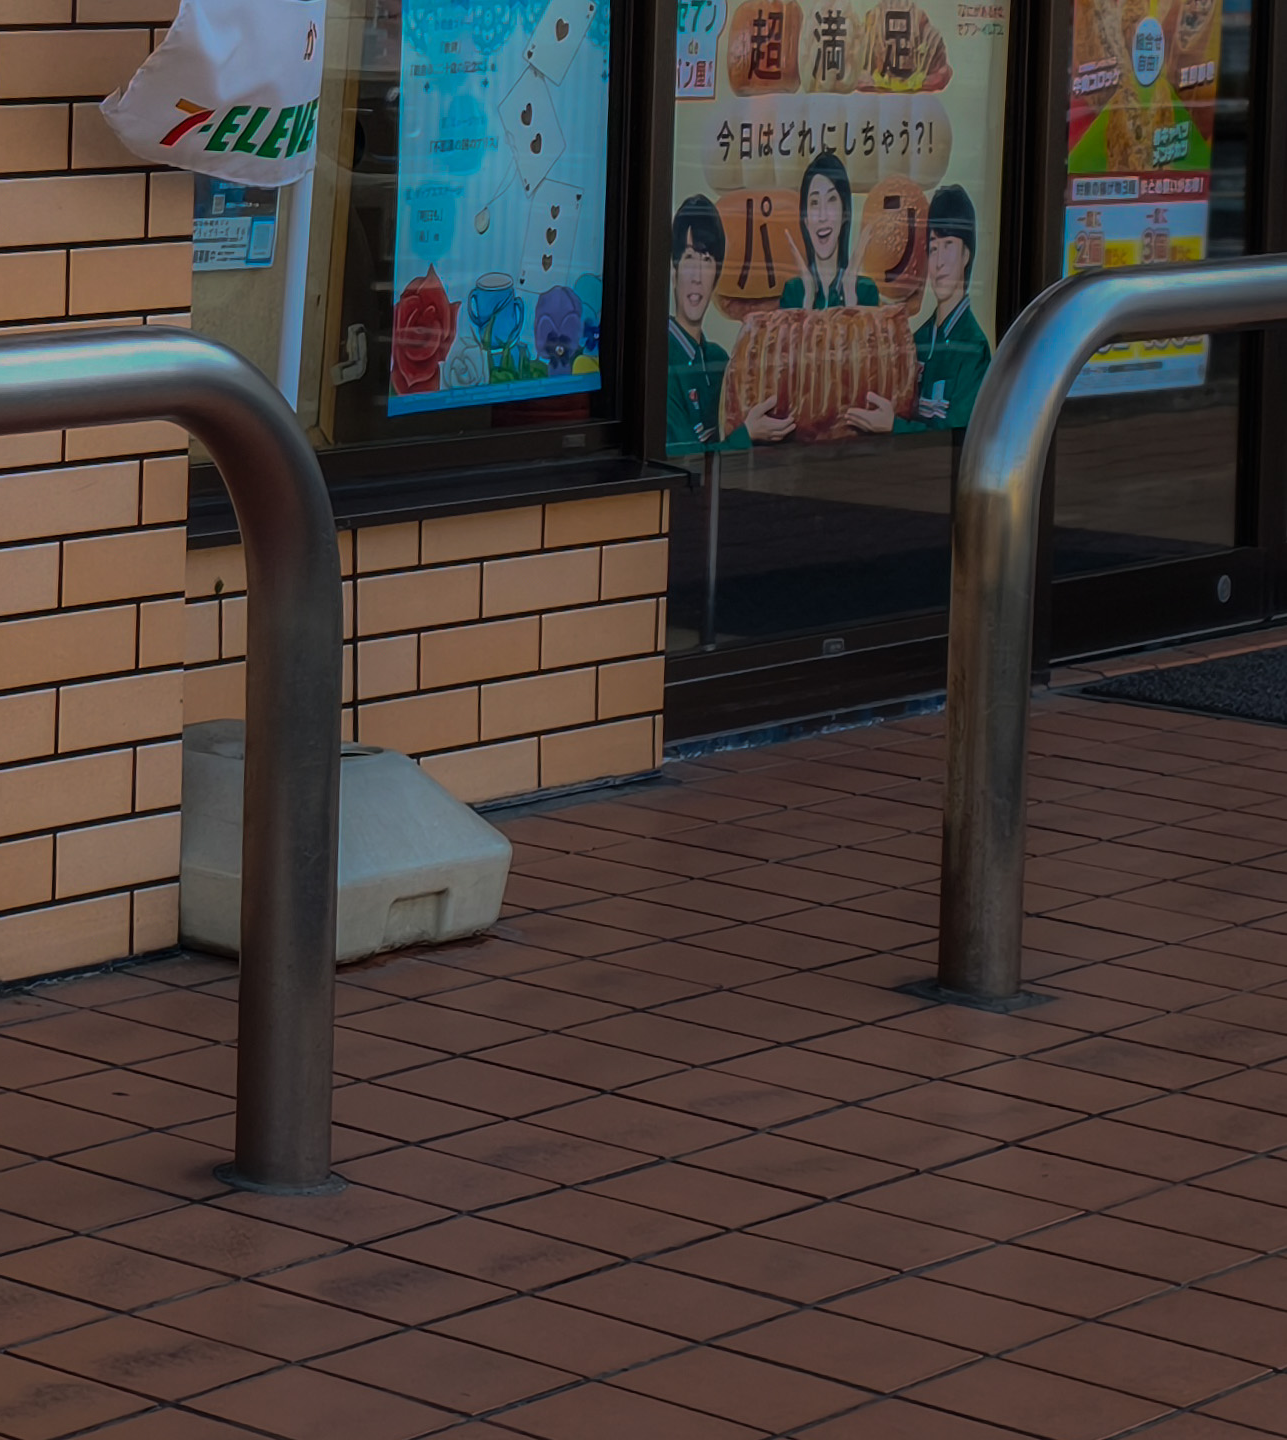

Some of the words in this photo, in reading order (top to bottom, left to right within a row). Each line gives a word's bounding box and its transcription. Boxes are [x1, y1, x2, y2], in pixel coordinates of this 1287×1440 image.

[716, 120, 935, 160] 今日はどれにしちゃう?!
